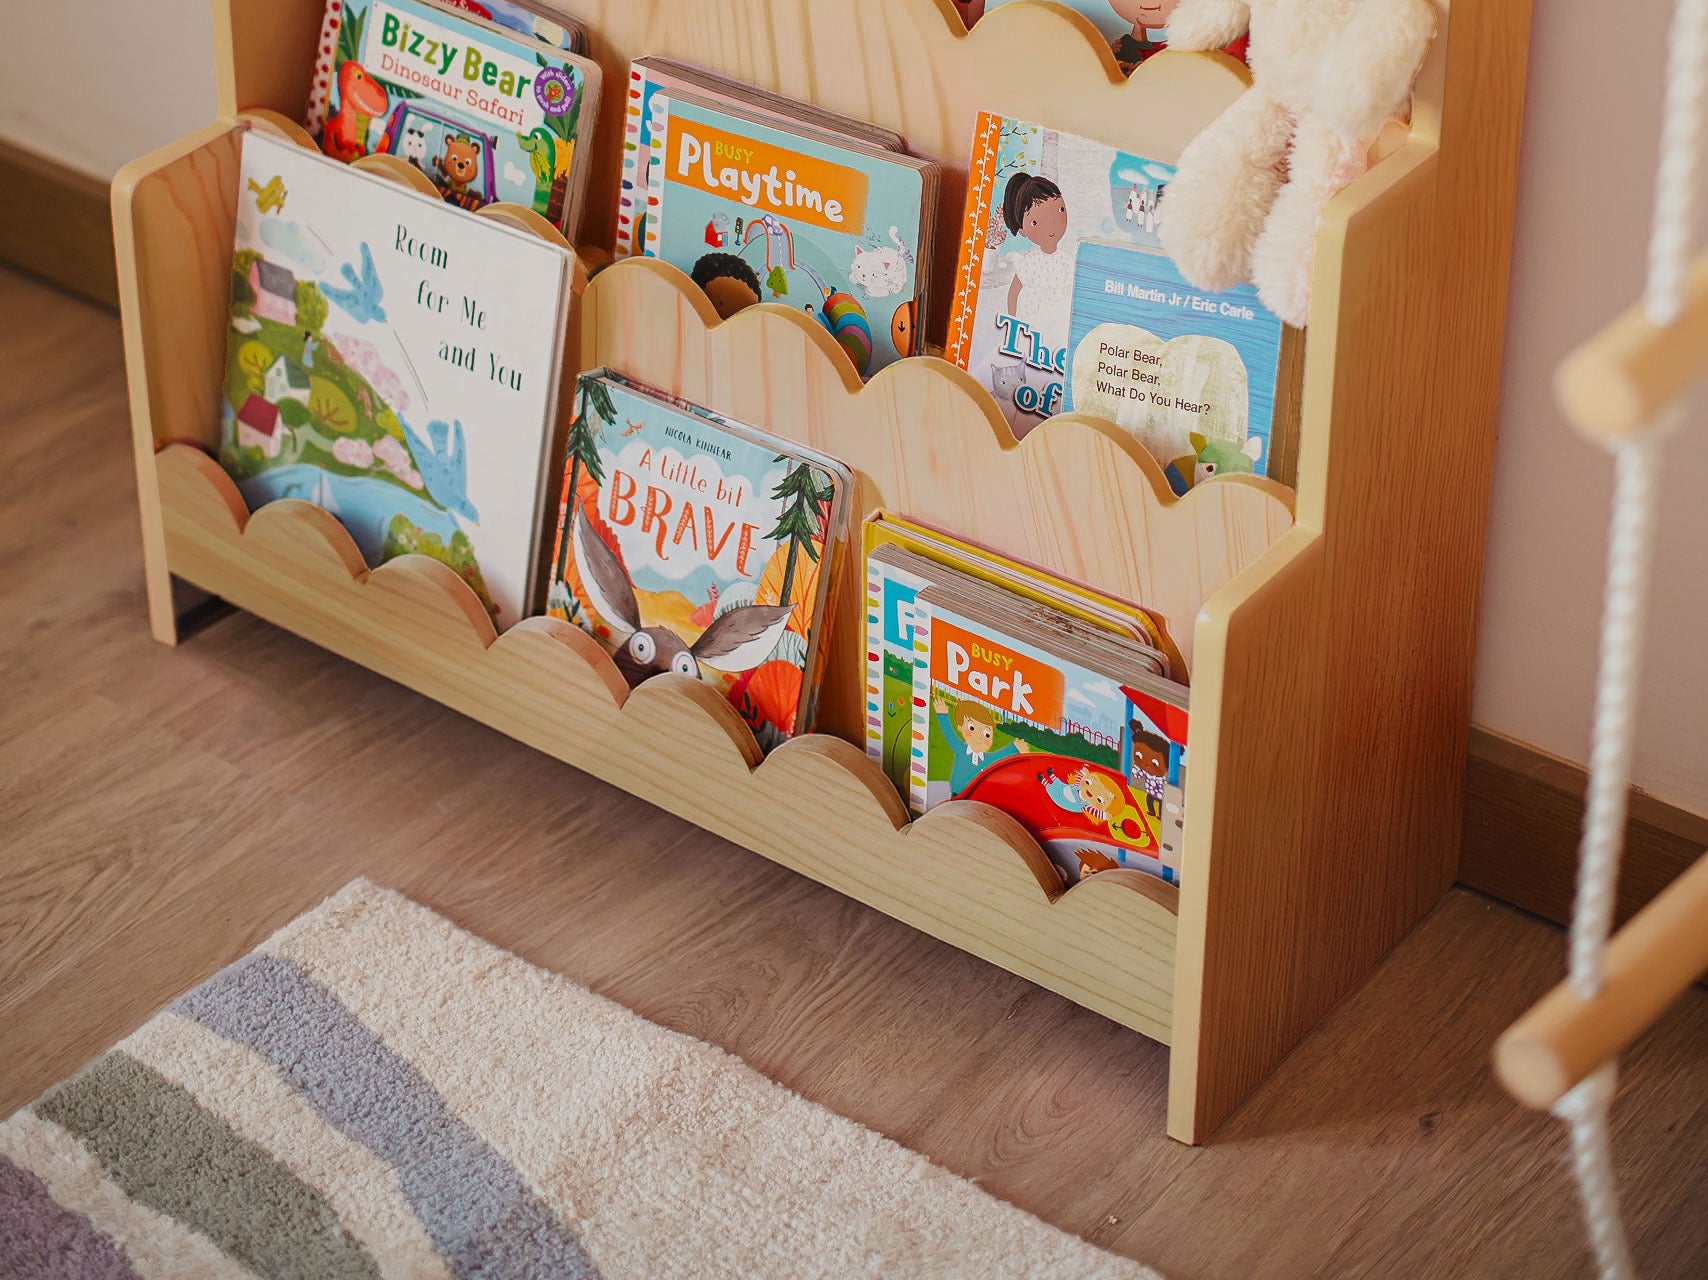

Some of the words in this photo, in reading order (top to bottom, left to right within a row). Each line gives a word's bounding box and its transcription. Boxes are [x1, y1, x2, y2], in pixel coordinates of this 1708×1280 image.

[381, 12, 458, 76] Bizzy
[462, 45, 532, 99] Bear
[380, 52, 463, 100] Dinosaur
[465, 88, 525, 127] Safari
[714, 140, 754, 165] BUSY
[677, 132, 844, 223] Playtime
[395, 223, 449, 270] Room
[417, 279, 449, 313] for
[460, 295, 488, 331] Me
[1104, 279, 1125, 297] Bill
[1127, 283, 1166, 304] Martin
[1168, 292, 1183, 307] Jr
[1191, 296, 1217, 313] Eric
[1219, 301, 1255, 321] Carle
[438, 340, 476, 372] and
[489, 351, 523, 392] You
[1097, 361, 1128, 379] Polar
[1131, 368, 1161, 387] Bear,
[1099, 342, 1130, 359] Polar
[1133, 349, 1163, 368] Bear,
[1096, 380, 1126, 398] What
[1129, 387, 1146, 402] Do
[1149, 391, 1171, 407] You
[1175, 397, 1211, 415] Hear?
[664, 426, 693, 445] NICOLA
[695, 438, 733, 462] KINNEAR
[638, 448, 651, 471] A
[660, 454, 708, 493] little
[716, 478, 743, 508] bit
[609, 469, 760, 578] BRAVE
[946, 640, 1035, 715] Park
[971, 642, 1014, 671] BUSY
